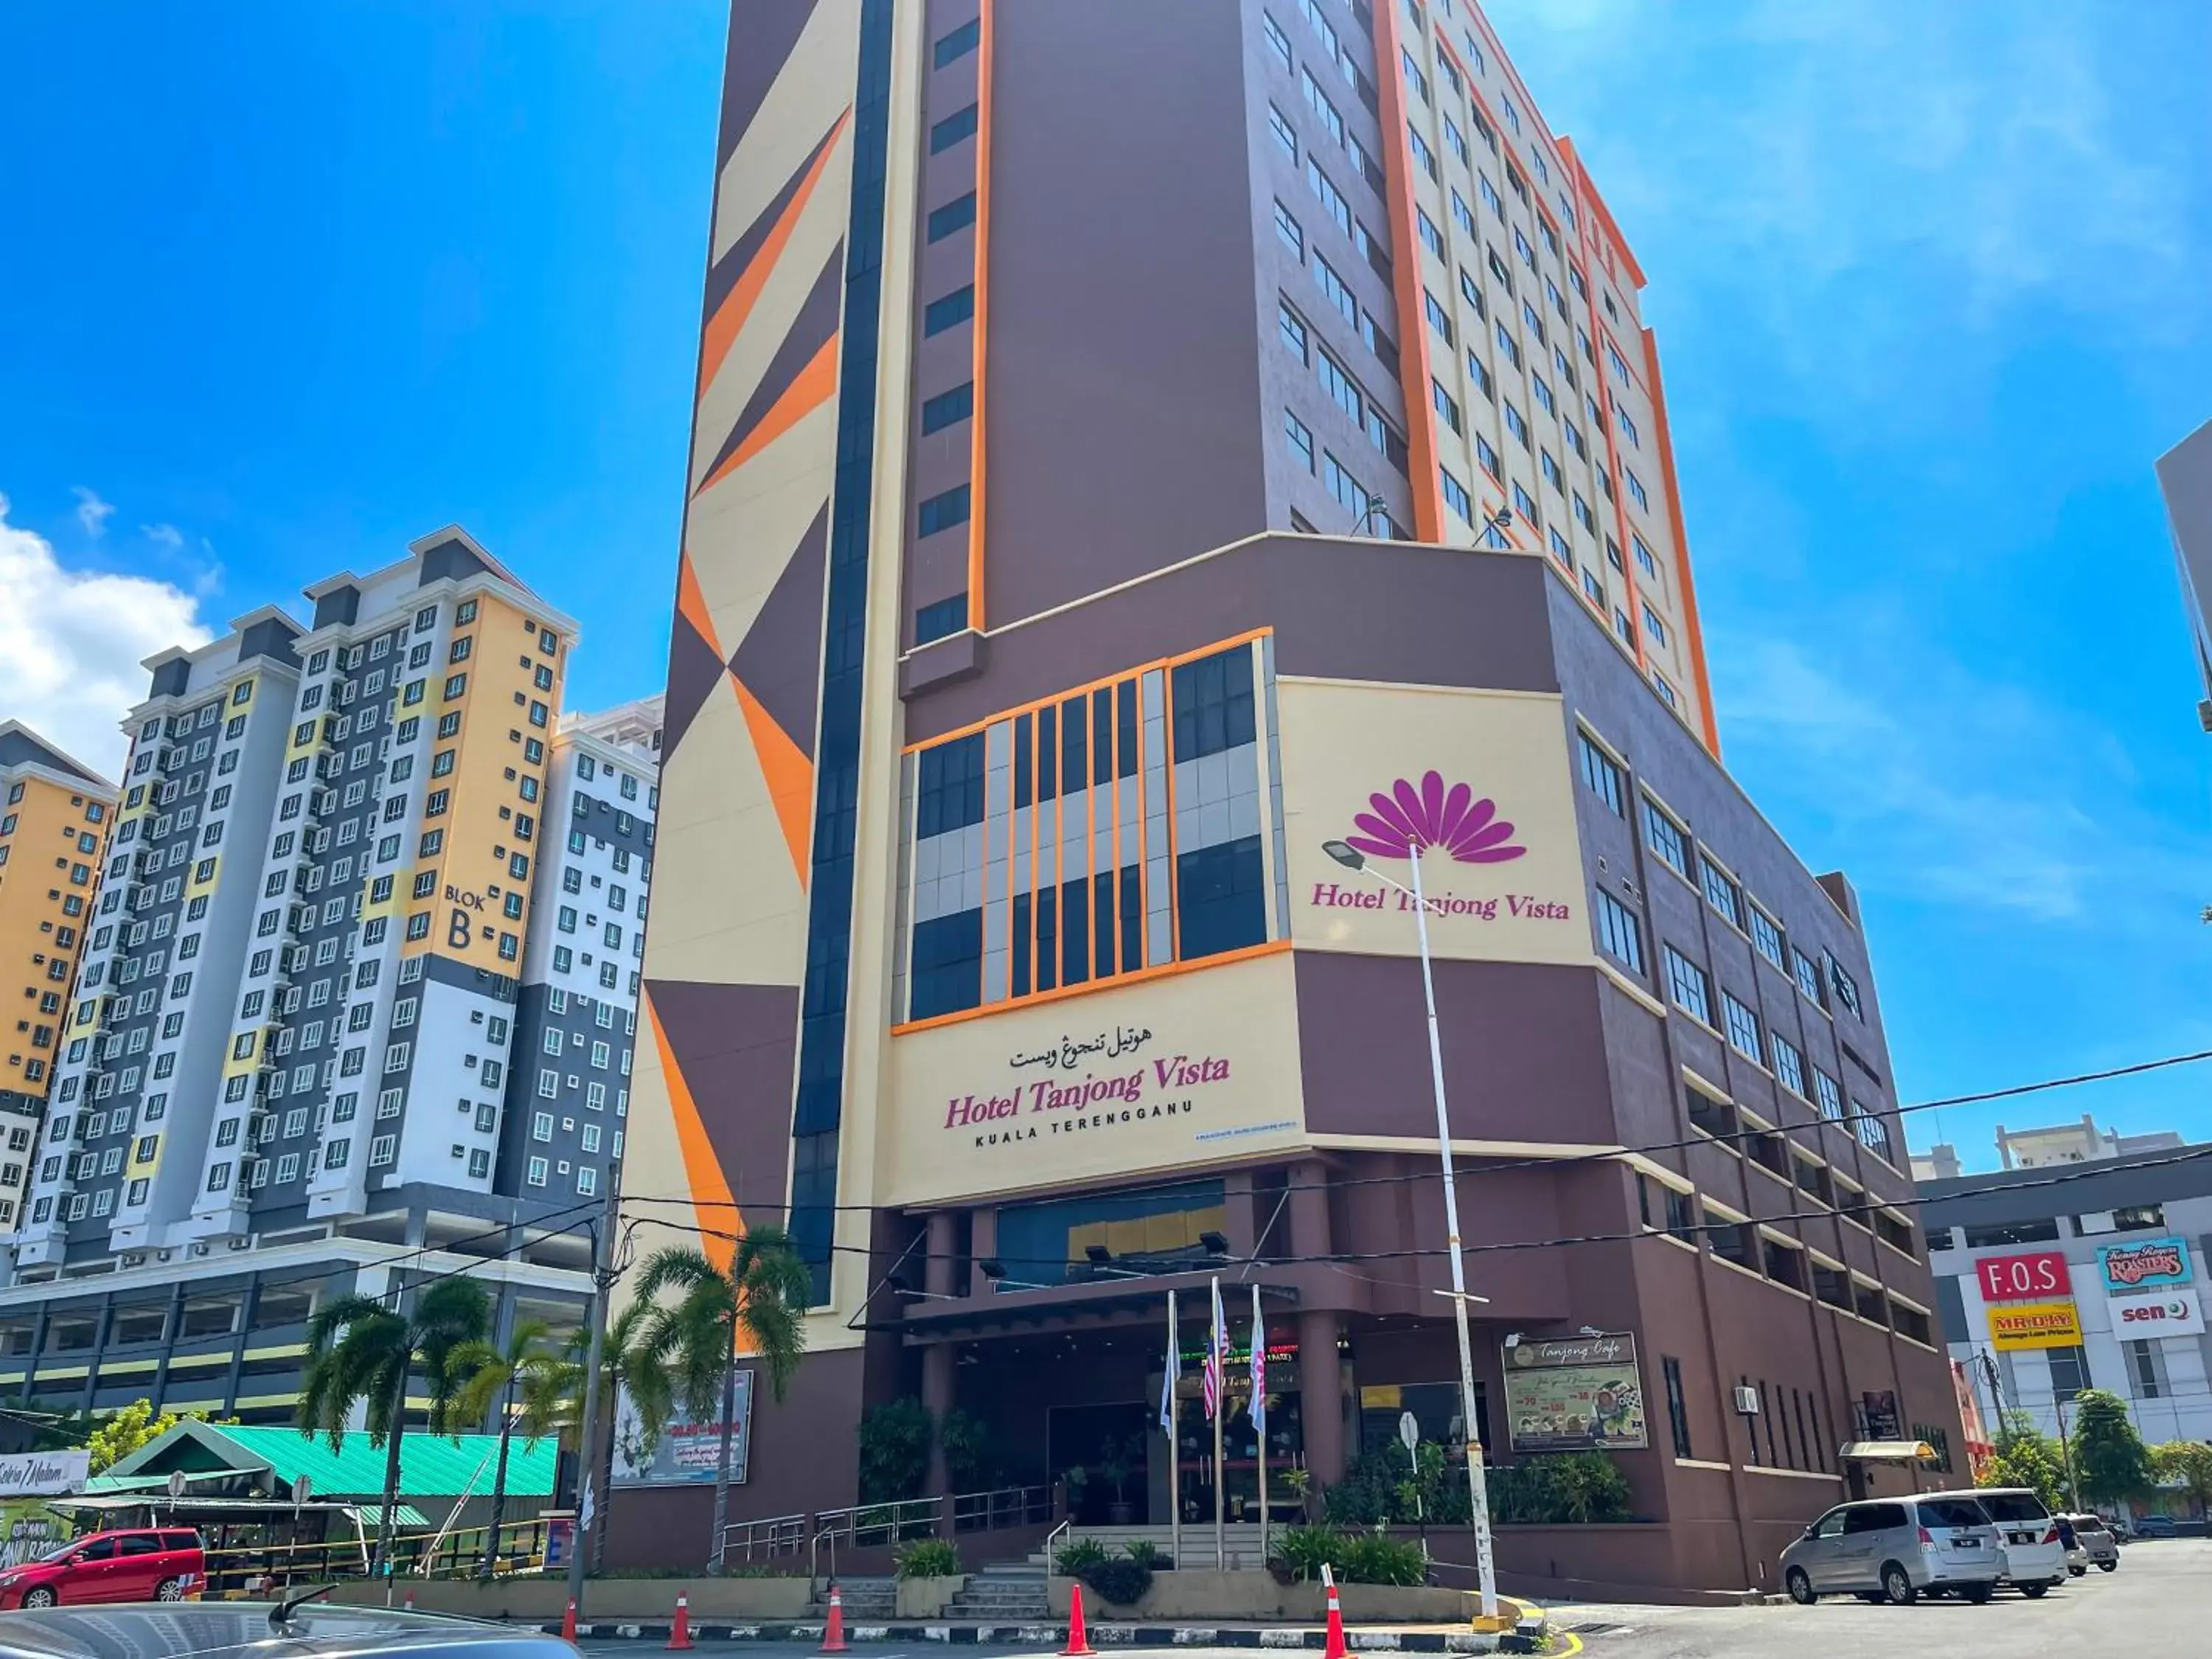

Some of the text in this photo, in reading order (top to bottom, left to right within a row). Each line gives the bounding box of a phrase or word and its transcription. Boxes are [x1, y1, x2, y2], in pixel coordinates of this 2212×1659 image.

[445, 885, 487, 911] BLOK
[1310, 883, 1386, 909] Hotel
[1505, 894, 1569, 919] Vista
[448, 908, 470, 949] B
[943, 1055, 1231, 1129] Hotel Tanjong Vista
[975, 1127, 1037, 1147] KUALA
[1051, 1100, 1192, 1133] TERENGGANU
[1988, 1259, 2056, 1294] F.O.S
[2108, 1255, 2183, 1281] ROASTERS
[1542, 1343, 1588, 1364] Tanjong
